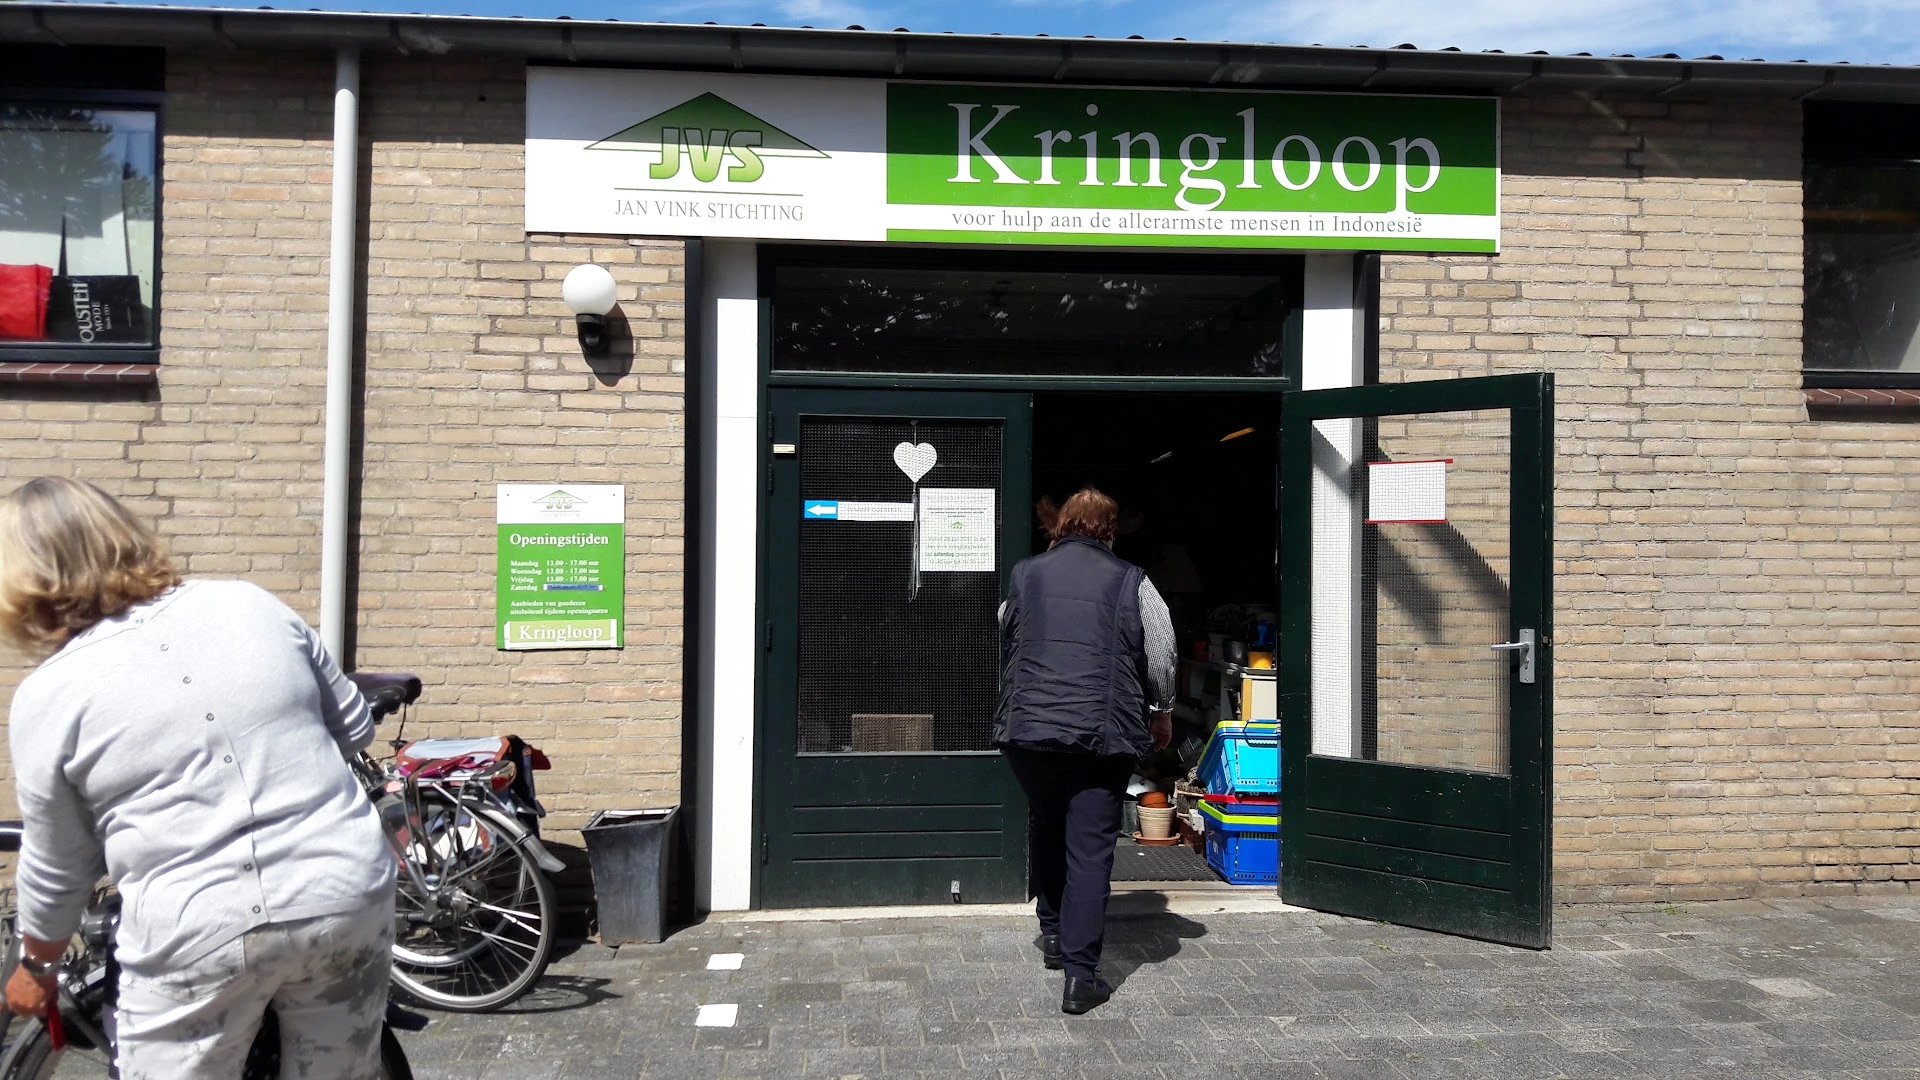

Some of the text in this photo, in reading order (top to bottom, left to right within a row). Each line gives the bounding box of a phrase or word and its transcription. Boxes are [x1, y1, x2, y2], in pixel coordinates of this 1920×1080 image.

[649, 126, 764, 182] JVS
[946, 103, 1440, 213] Kringloop
[615, 200, 804, 220] JAN VINK STICHTING
[952, 210, 1423, 232] voor hulp aan de allerarmste mensen in Indonesië
[92, 302, 104, 332] MODE
[546, 496, 572, 509] JVS
[510, 533, 609, 548] Openingstijden
[520, 624, 602, 642] Kringloop
